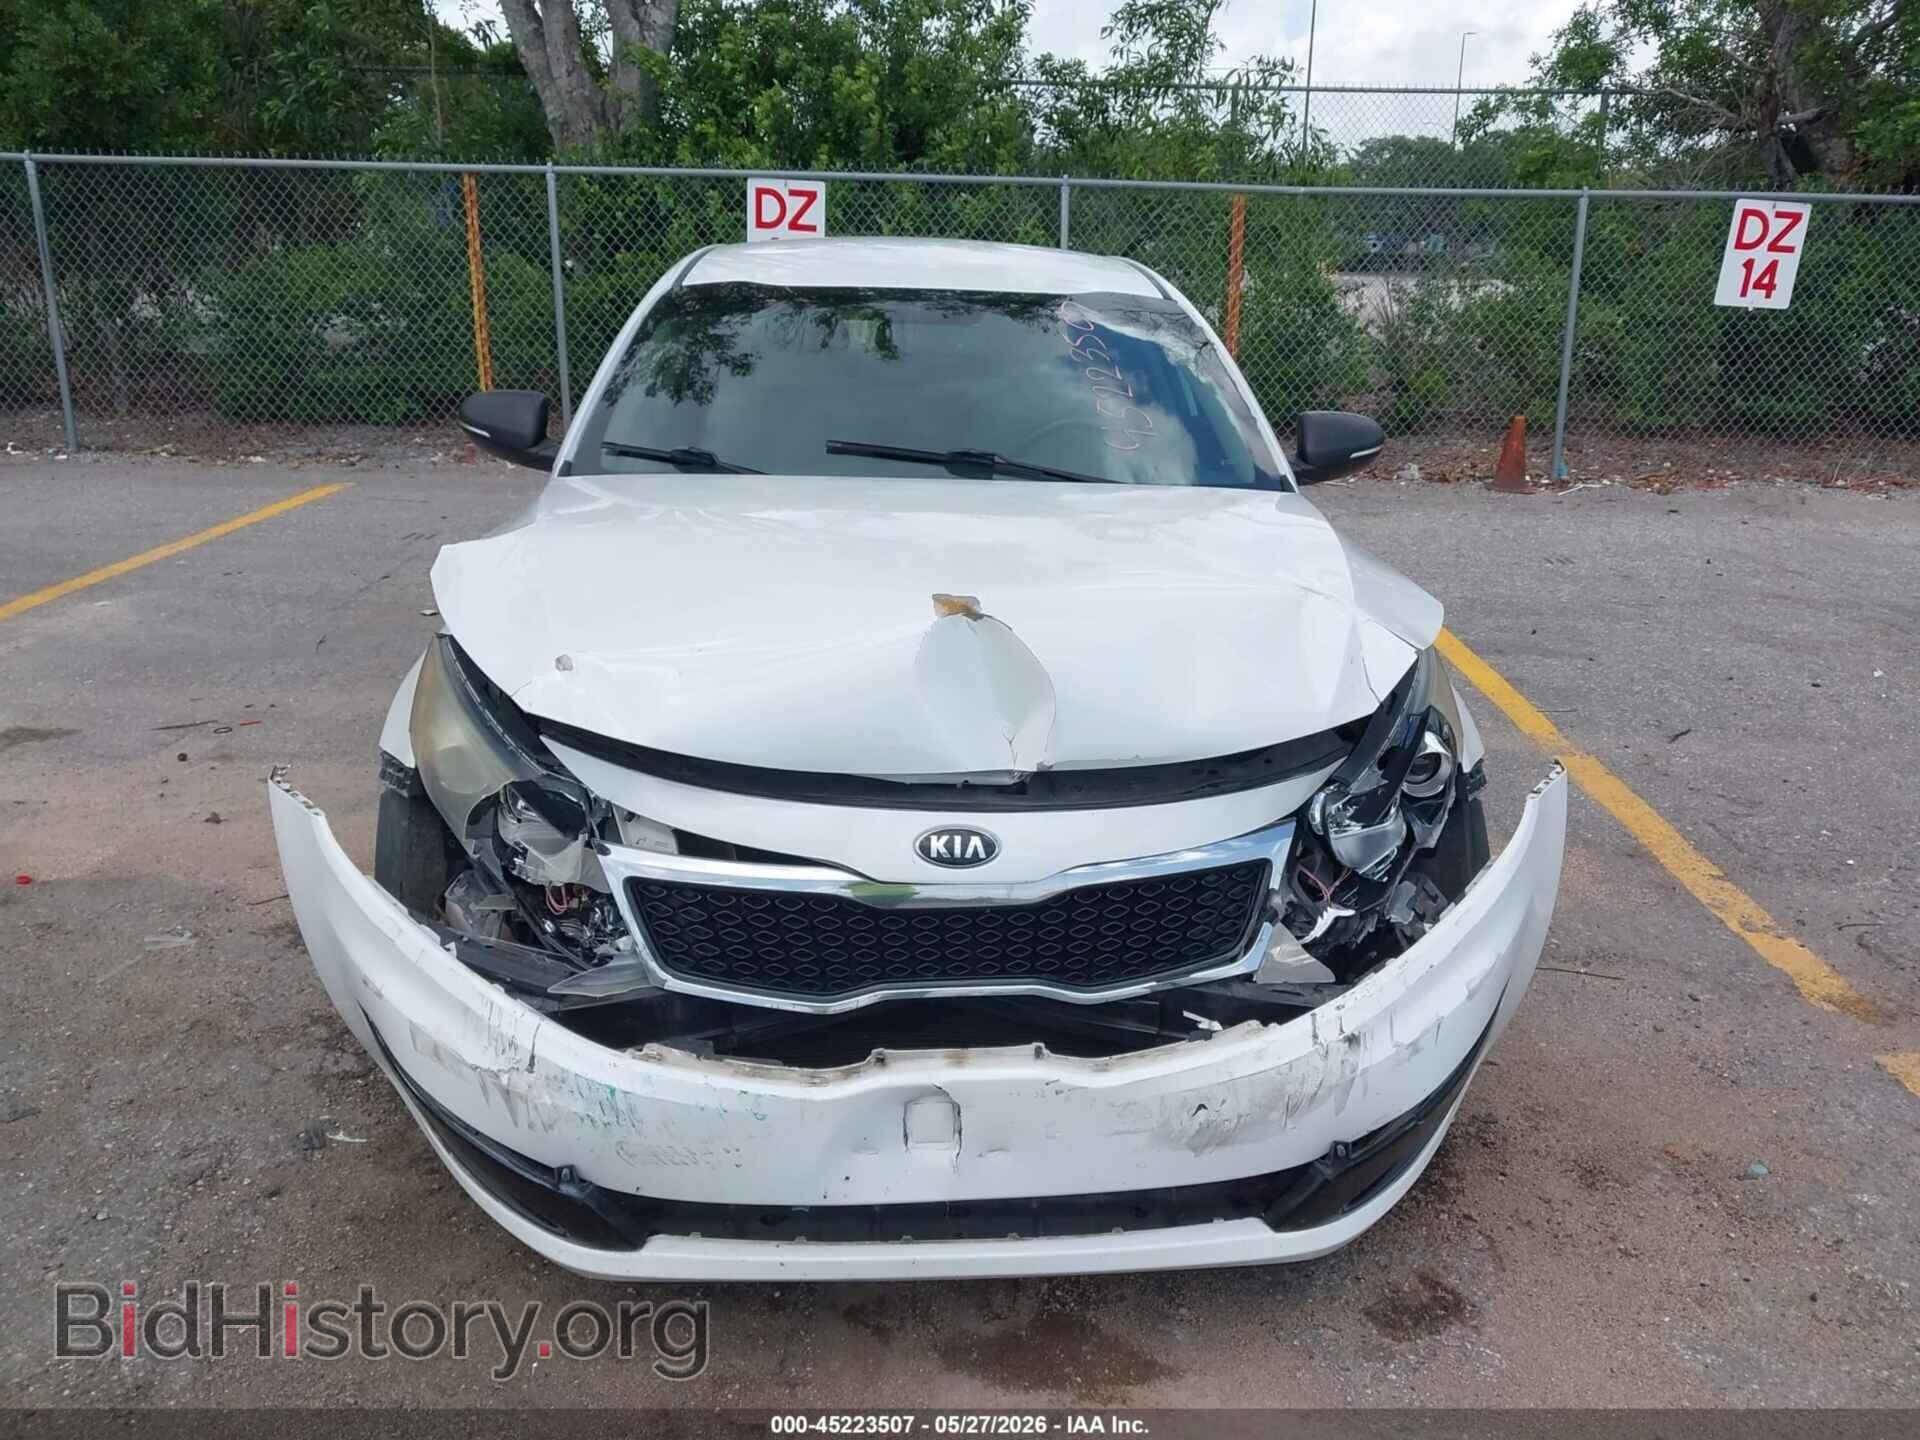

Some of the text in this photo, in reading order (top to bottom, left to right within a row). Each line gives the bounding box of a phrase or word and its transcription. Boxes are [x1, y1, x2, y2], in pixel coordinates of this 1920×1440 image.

[754, 187, 818, 233] DZ
[1733, 207, 1804, 254] DZ
[1739, 257, 1780, 299] 14
[929, 834, 987, 859] KIA
